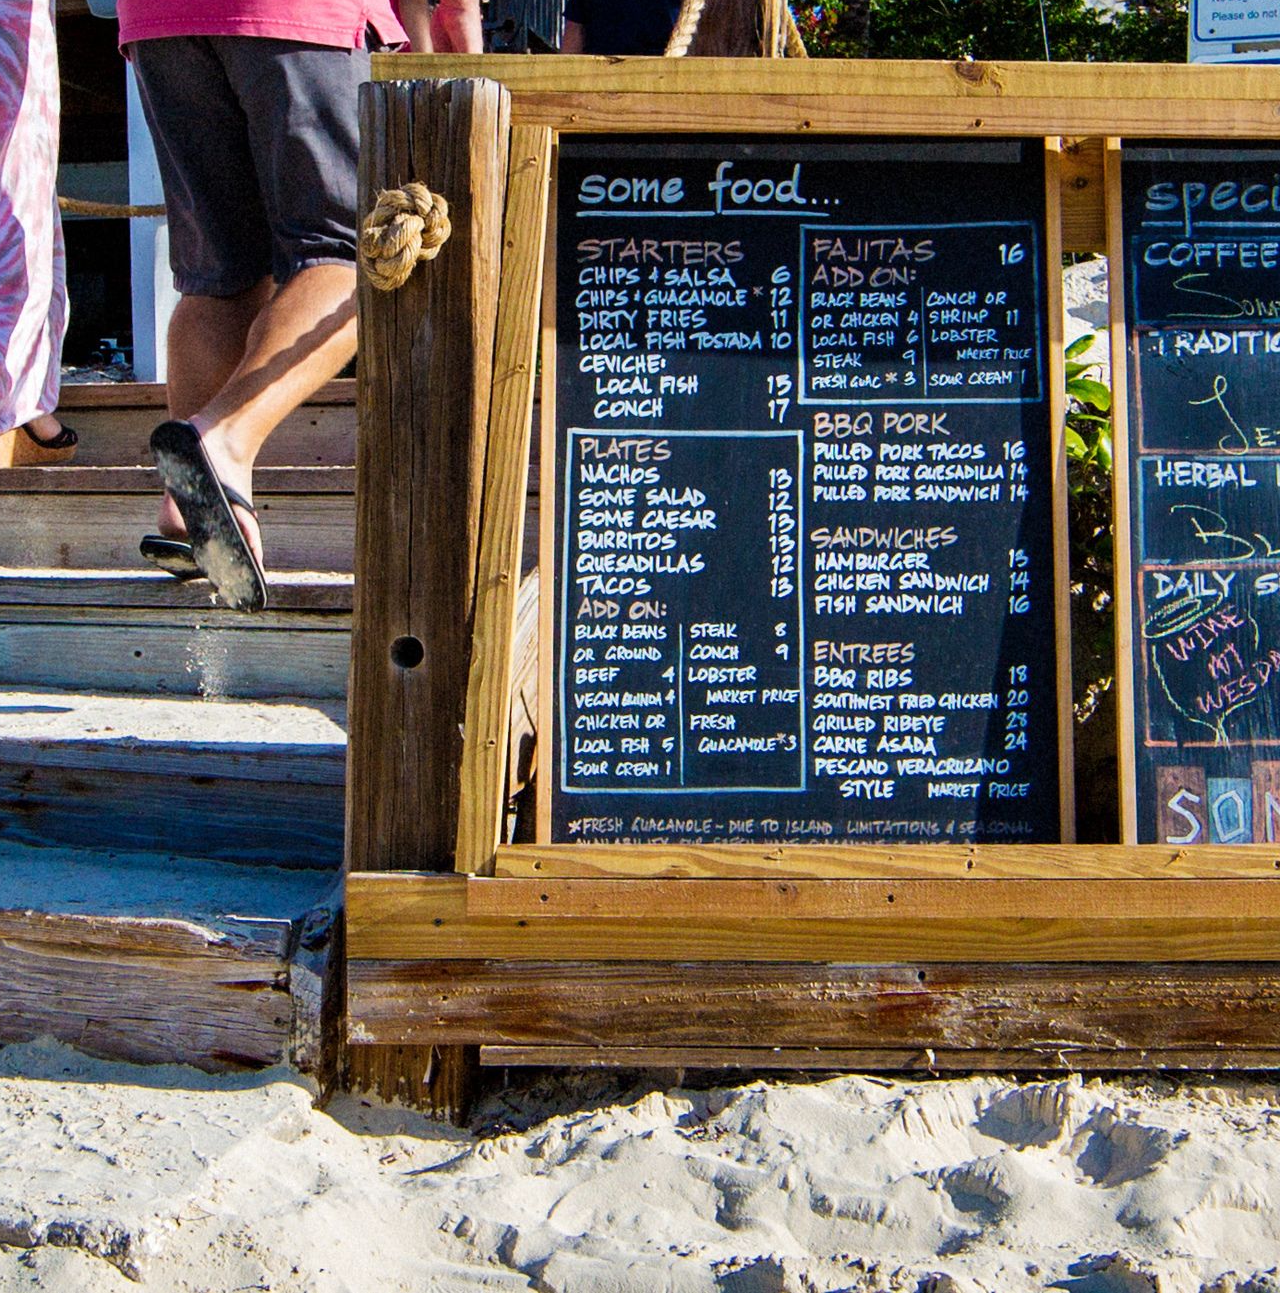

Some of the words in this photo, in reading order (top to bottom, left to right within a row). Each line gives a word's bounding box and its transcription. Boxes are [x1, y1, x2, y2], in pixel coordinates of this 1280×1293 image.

[578, 176, 684, 204] some
[709, 161, 841, 215] food...
[576, 239, 744, 266] STARTERS
[813, 238, 936, 264] FAJITAS
[998, 243, 1025, 265] 16
[1144, 241, 1279, 267] COFFEE
[812, 268, 864, 288] ADD
[870, 268, 917, 287] ON:
[580, 311, 638, 332] DIRTY
[647, 310, 707, 329] FRIES
[770, 311, 788, 328] 11
[580, 354, 668, 374] CEVICHE:
[594, 400, 663, 419] CONCH
[767, 399, 789, 424] 17
[813, 413, 873, 439] BBQ
[883, 410, 952, 436] PORK
[580, 438, 673, 463] PLATES
[580, 465, 660, 484] NACHOS
[769, 469, 792, 488] 13
[1155, 462, 1257, 487] HERBAL
[579, 488, 635, 506] SOME
[645, 488, 706, 506] SALAD
[767, 492, 792, 511] 12
[577, 532, 677, 550] BURRITOS
[769, 534, 795, 554] 13
[810, 527, 959, 549] SANDWICHES
[576, 554, 705, 574] QUESADILLAS
[771, 556, 795, 574] 12
[814, 553, 930, 571] HAMBURGER
[1008, 549, 1029, 569] 13
[577, 577, 652, 596] TACOS
[770, 578, 794, 598] 13
[814, 573, 891, 592] CHICKEN
[898, 572, 990, 593] SANDWICH
[1009, 570, 1029, 589] 14
[1152, 572, 1235, 599] DAILY
[814, 595, 857, 614] FISH
[864, 595, 963, 615] SANDWICH
[1008, 596, 1030, 613] 16
[813, 641, 916, 663] ENTREES
[813, 668, 855, 686] BBQ
[866, 667, 913, 688] RIBS
[1008, 666, 1027, 684] 18
[812, 736, 868, 754] CARNE
[877, 735, 938, 756] ASADA
[1004, 735, 1028, 752] 24
